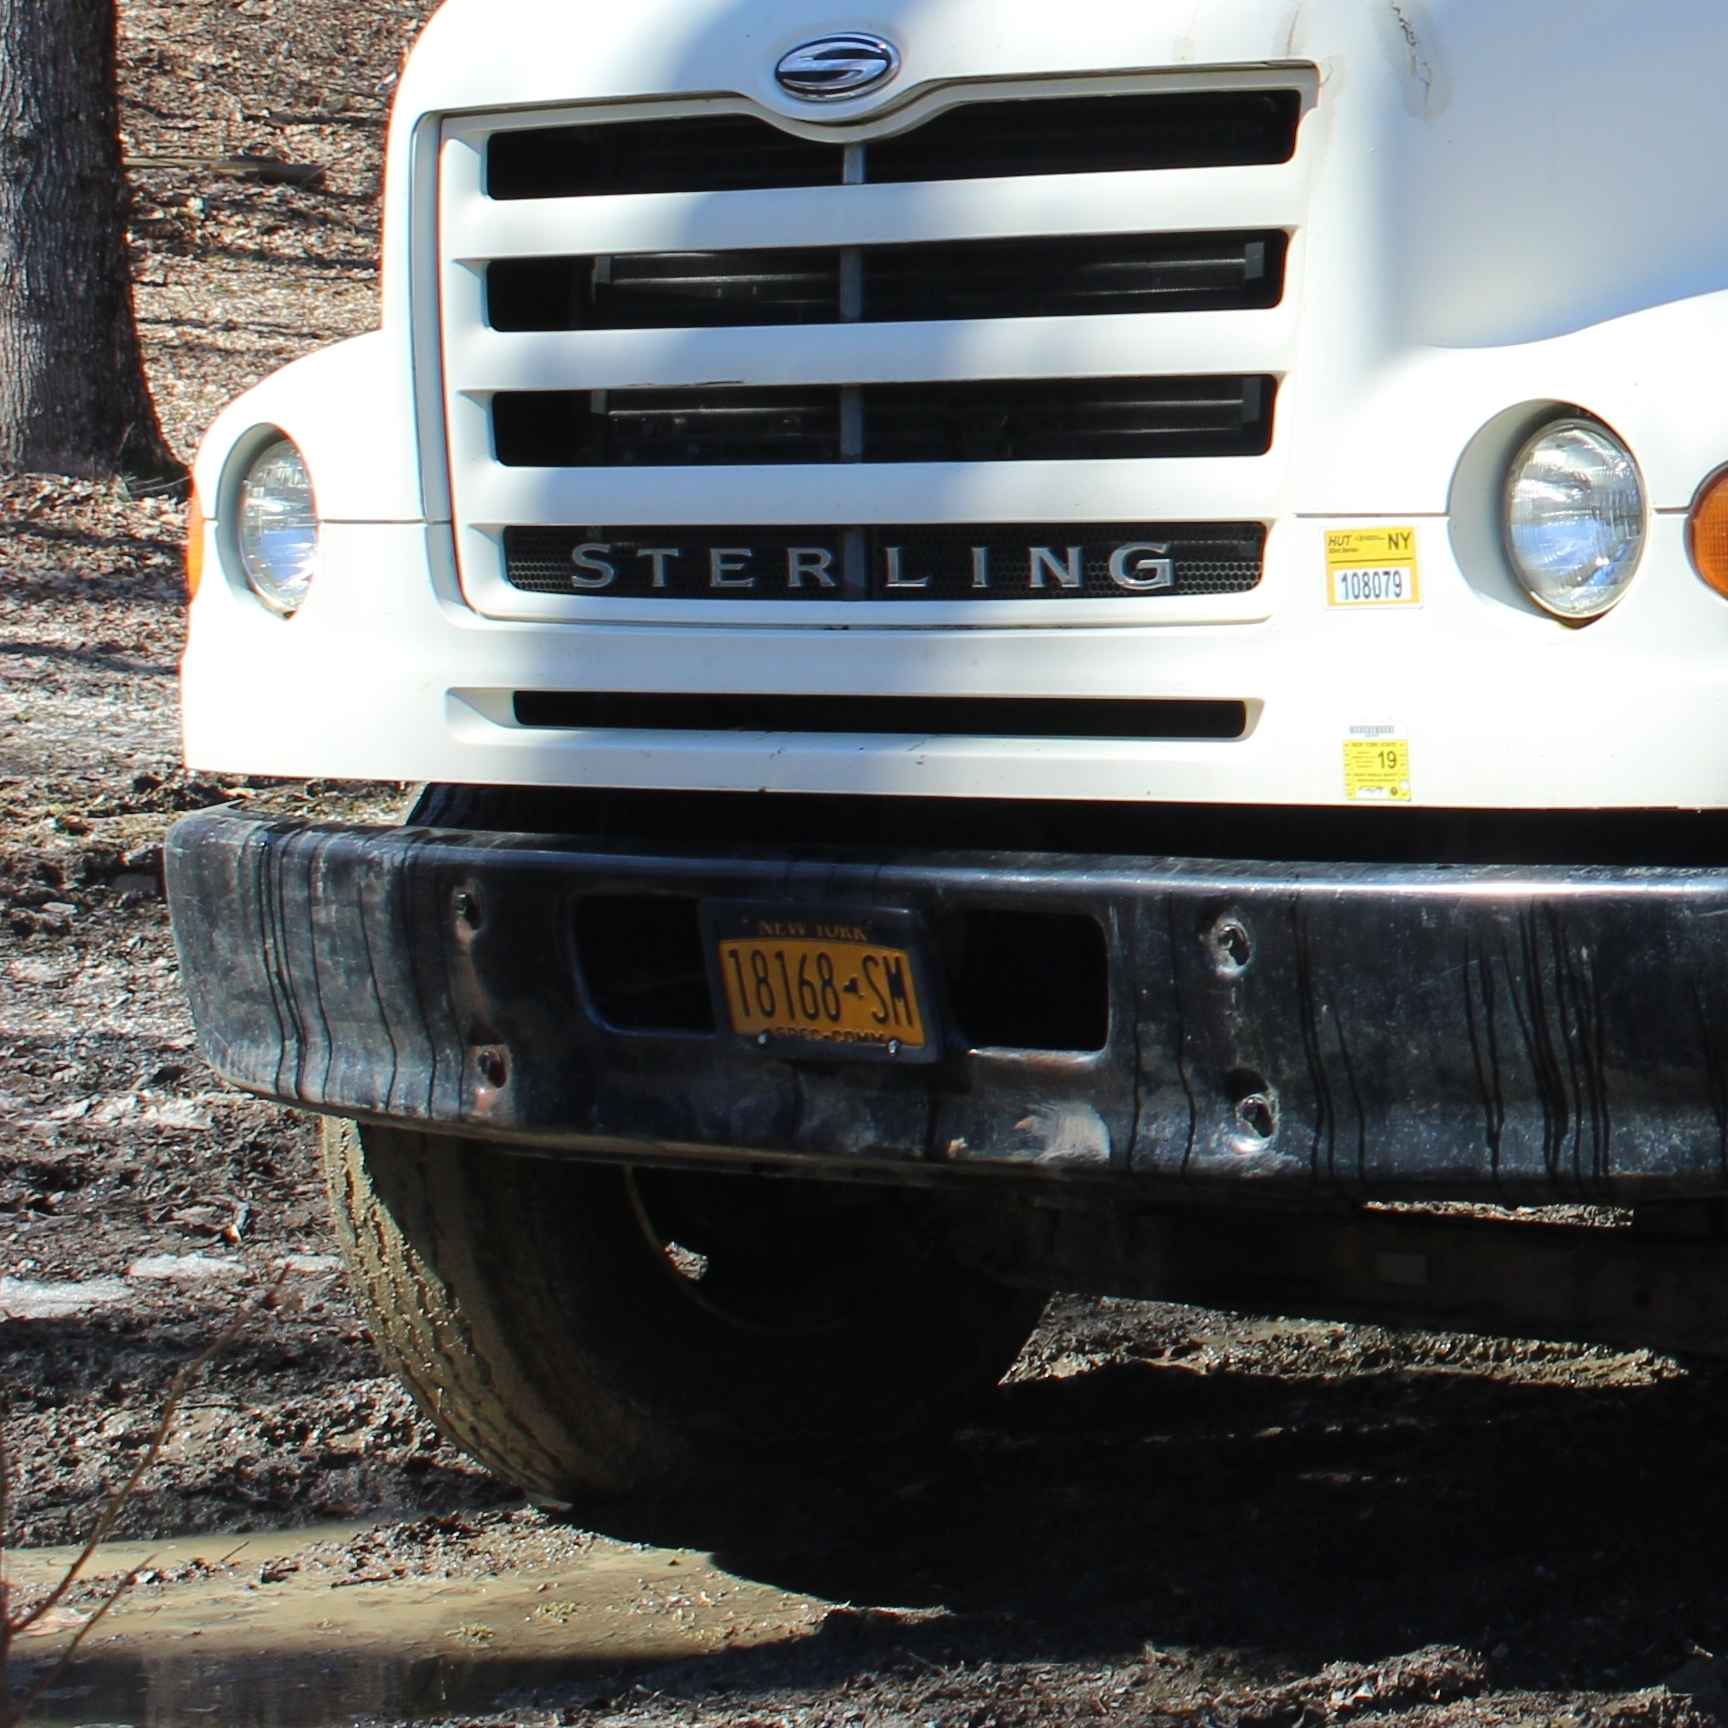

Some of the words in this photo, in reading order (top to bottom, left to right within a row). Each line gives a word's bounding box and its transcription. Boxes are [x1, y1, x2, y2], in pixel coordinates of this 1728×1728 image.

[1387, 532, 1412, 550] NY
[571, 540, 1176, 591] STERLING
[1341, 570, 1402, 599] 108079
[1378, 750, 1397, 769] 19
[758, 921, 807, 937] NEW
